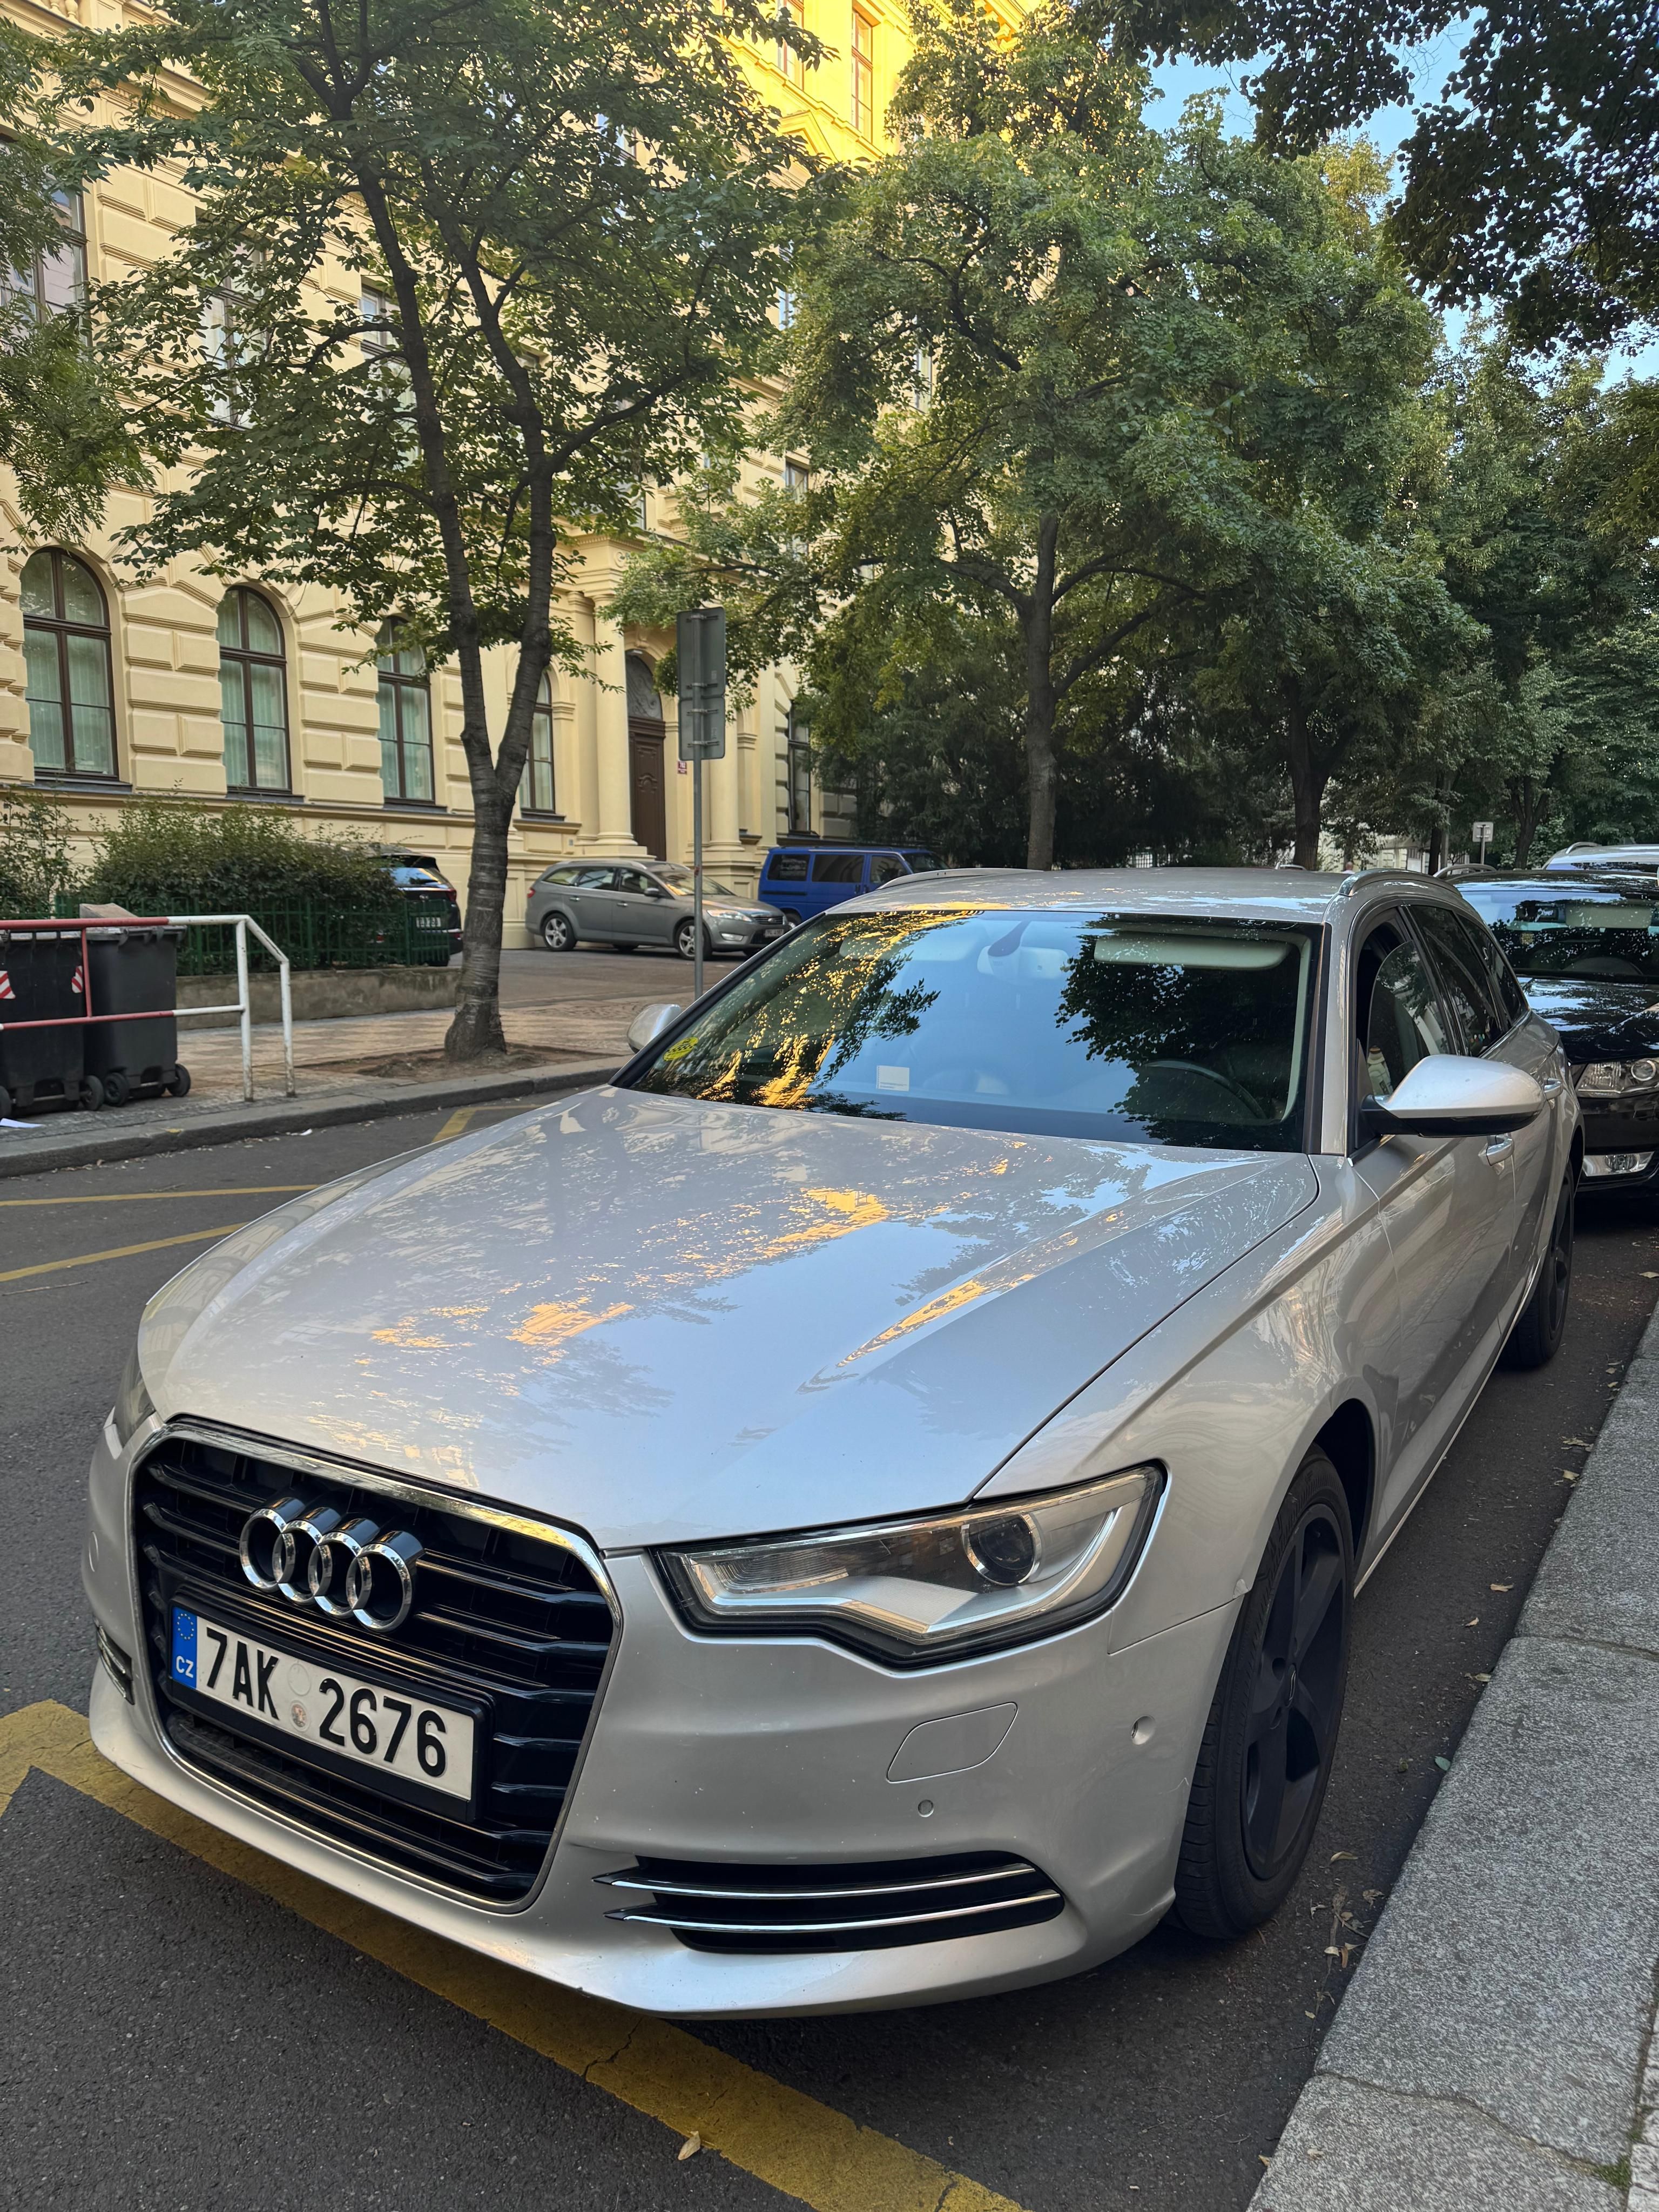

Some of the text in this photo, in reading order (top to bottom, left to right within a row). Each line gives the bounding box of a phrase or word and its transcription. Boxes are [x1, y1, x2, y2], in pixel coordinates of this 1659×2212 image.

[176, 1656, 194, 1678] CZ
[206, 1627, 447, 1777] 7AK 2676
